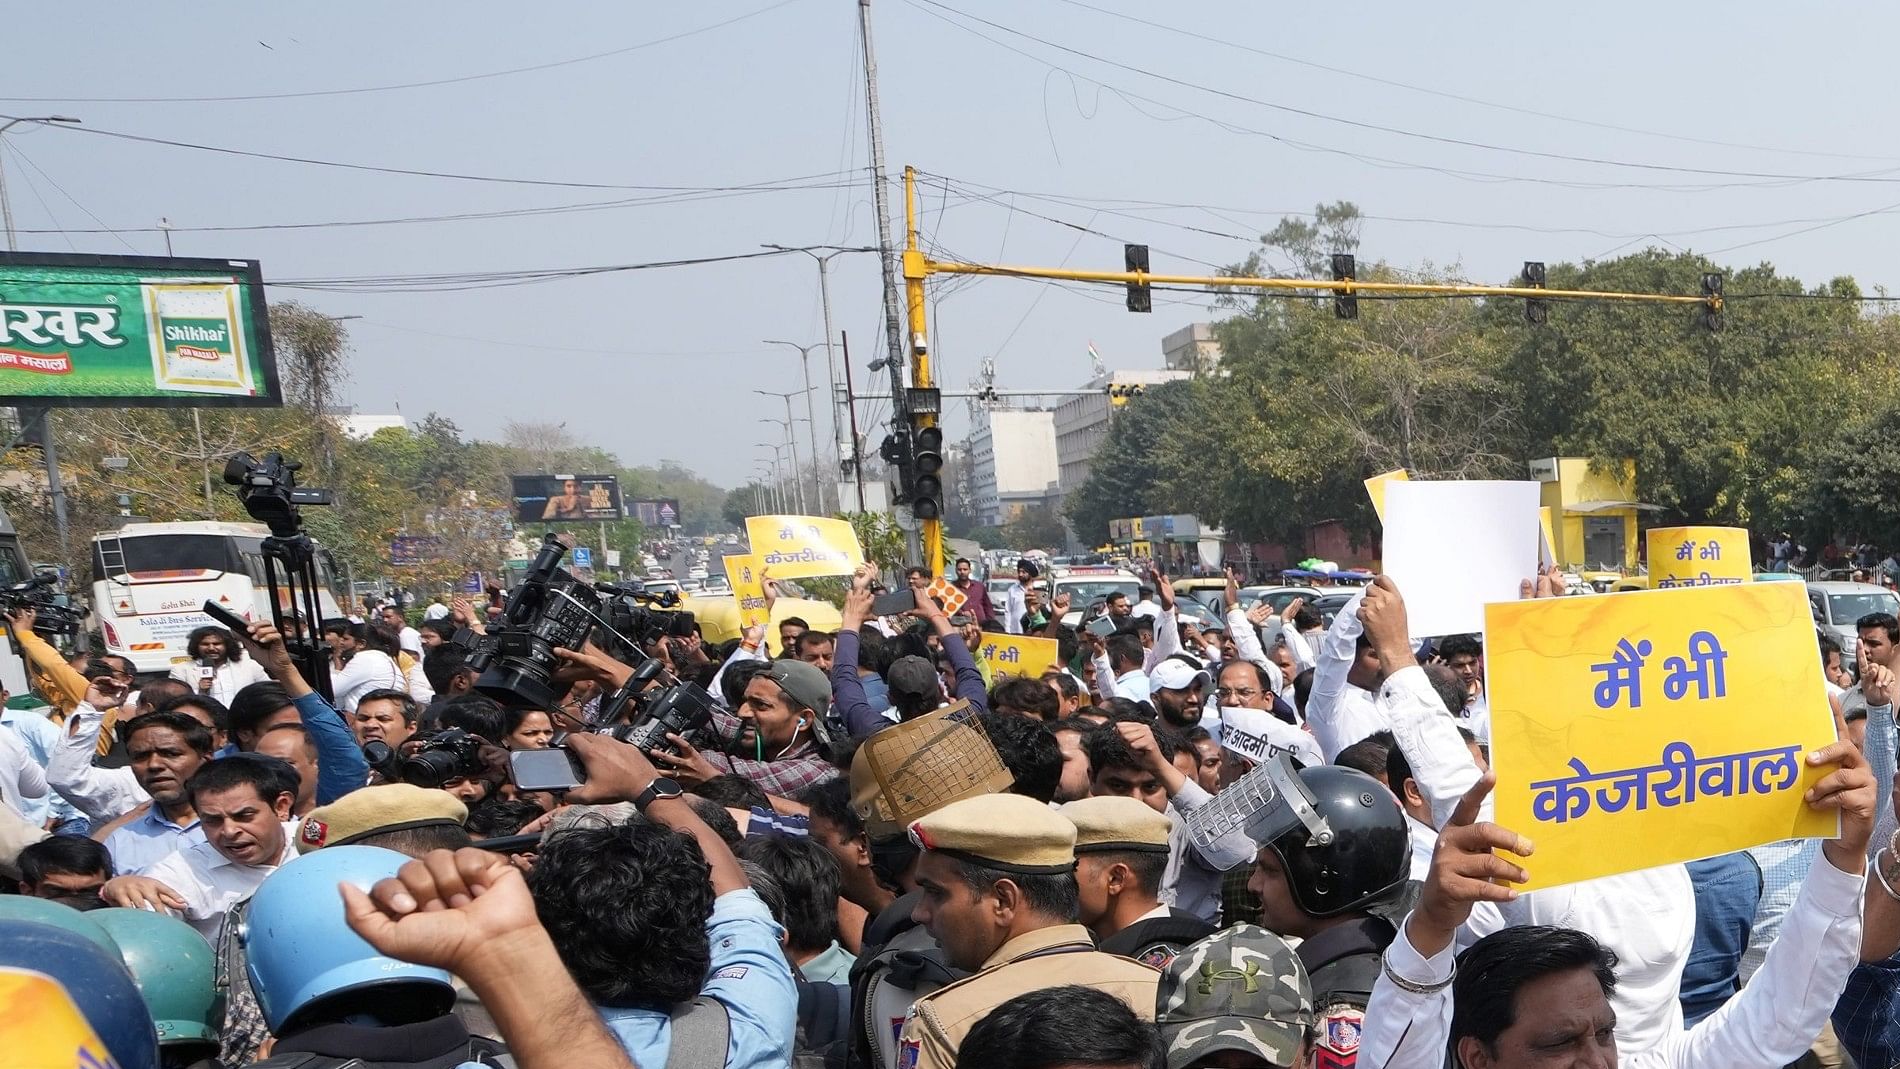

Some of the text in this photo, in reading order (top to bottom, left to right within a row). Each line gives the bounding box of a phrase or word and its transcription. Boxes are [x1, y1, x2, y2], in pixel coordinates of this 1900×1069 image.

[165, 323, 227, 343] Shikhar
[19, 354, 68, 371] मसाला
[1675, 540, 1722, 562] मैं भी
[999, 645, 1020, 664] भी
[1591, 630, 1728, 709] मैं भी
[1231, 728, 1269, 759] आदमी
[1531, 741, 1801, 824] केजरीवाल
